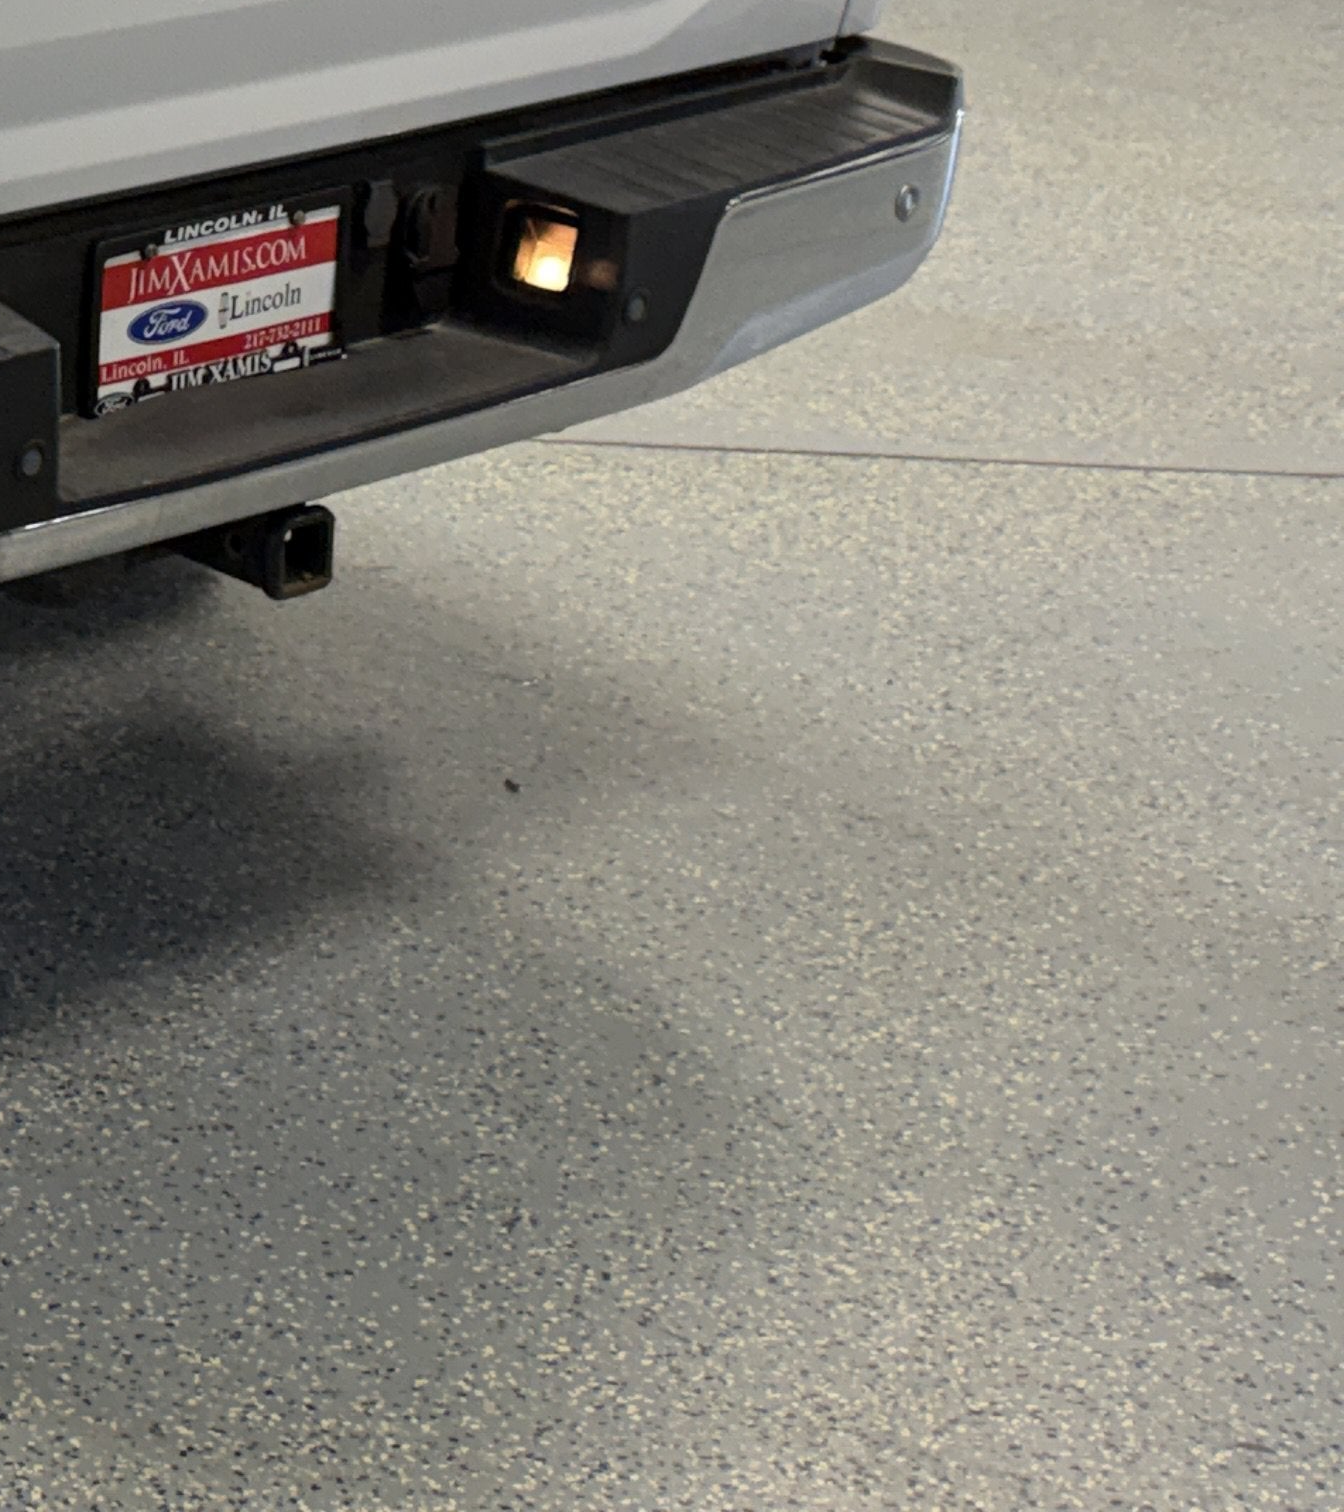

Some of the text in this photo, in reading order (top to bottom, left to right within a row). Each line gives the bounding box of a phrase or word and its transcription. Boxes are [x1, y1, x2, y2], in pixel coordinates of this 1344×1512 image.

[269, 203, 289, 221] IL
[143, 283, 302, 338] Ford Lincoln
[169, 351, 273, 391] JIM XAMIS
[172, 349, 190, 368] IL
